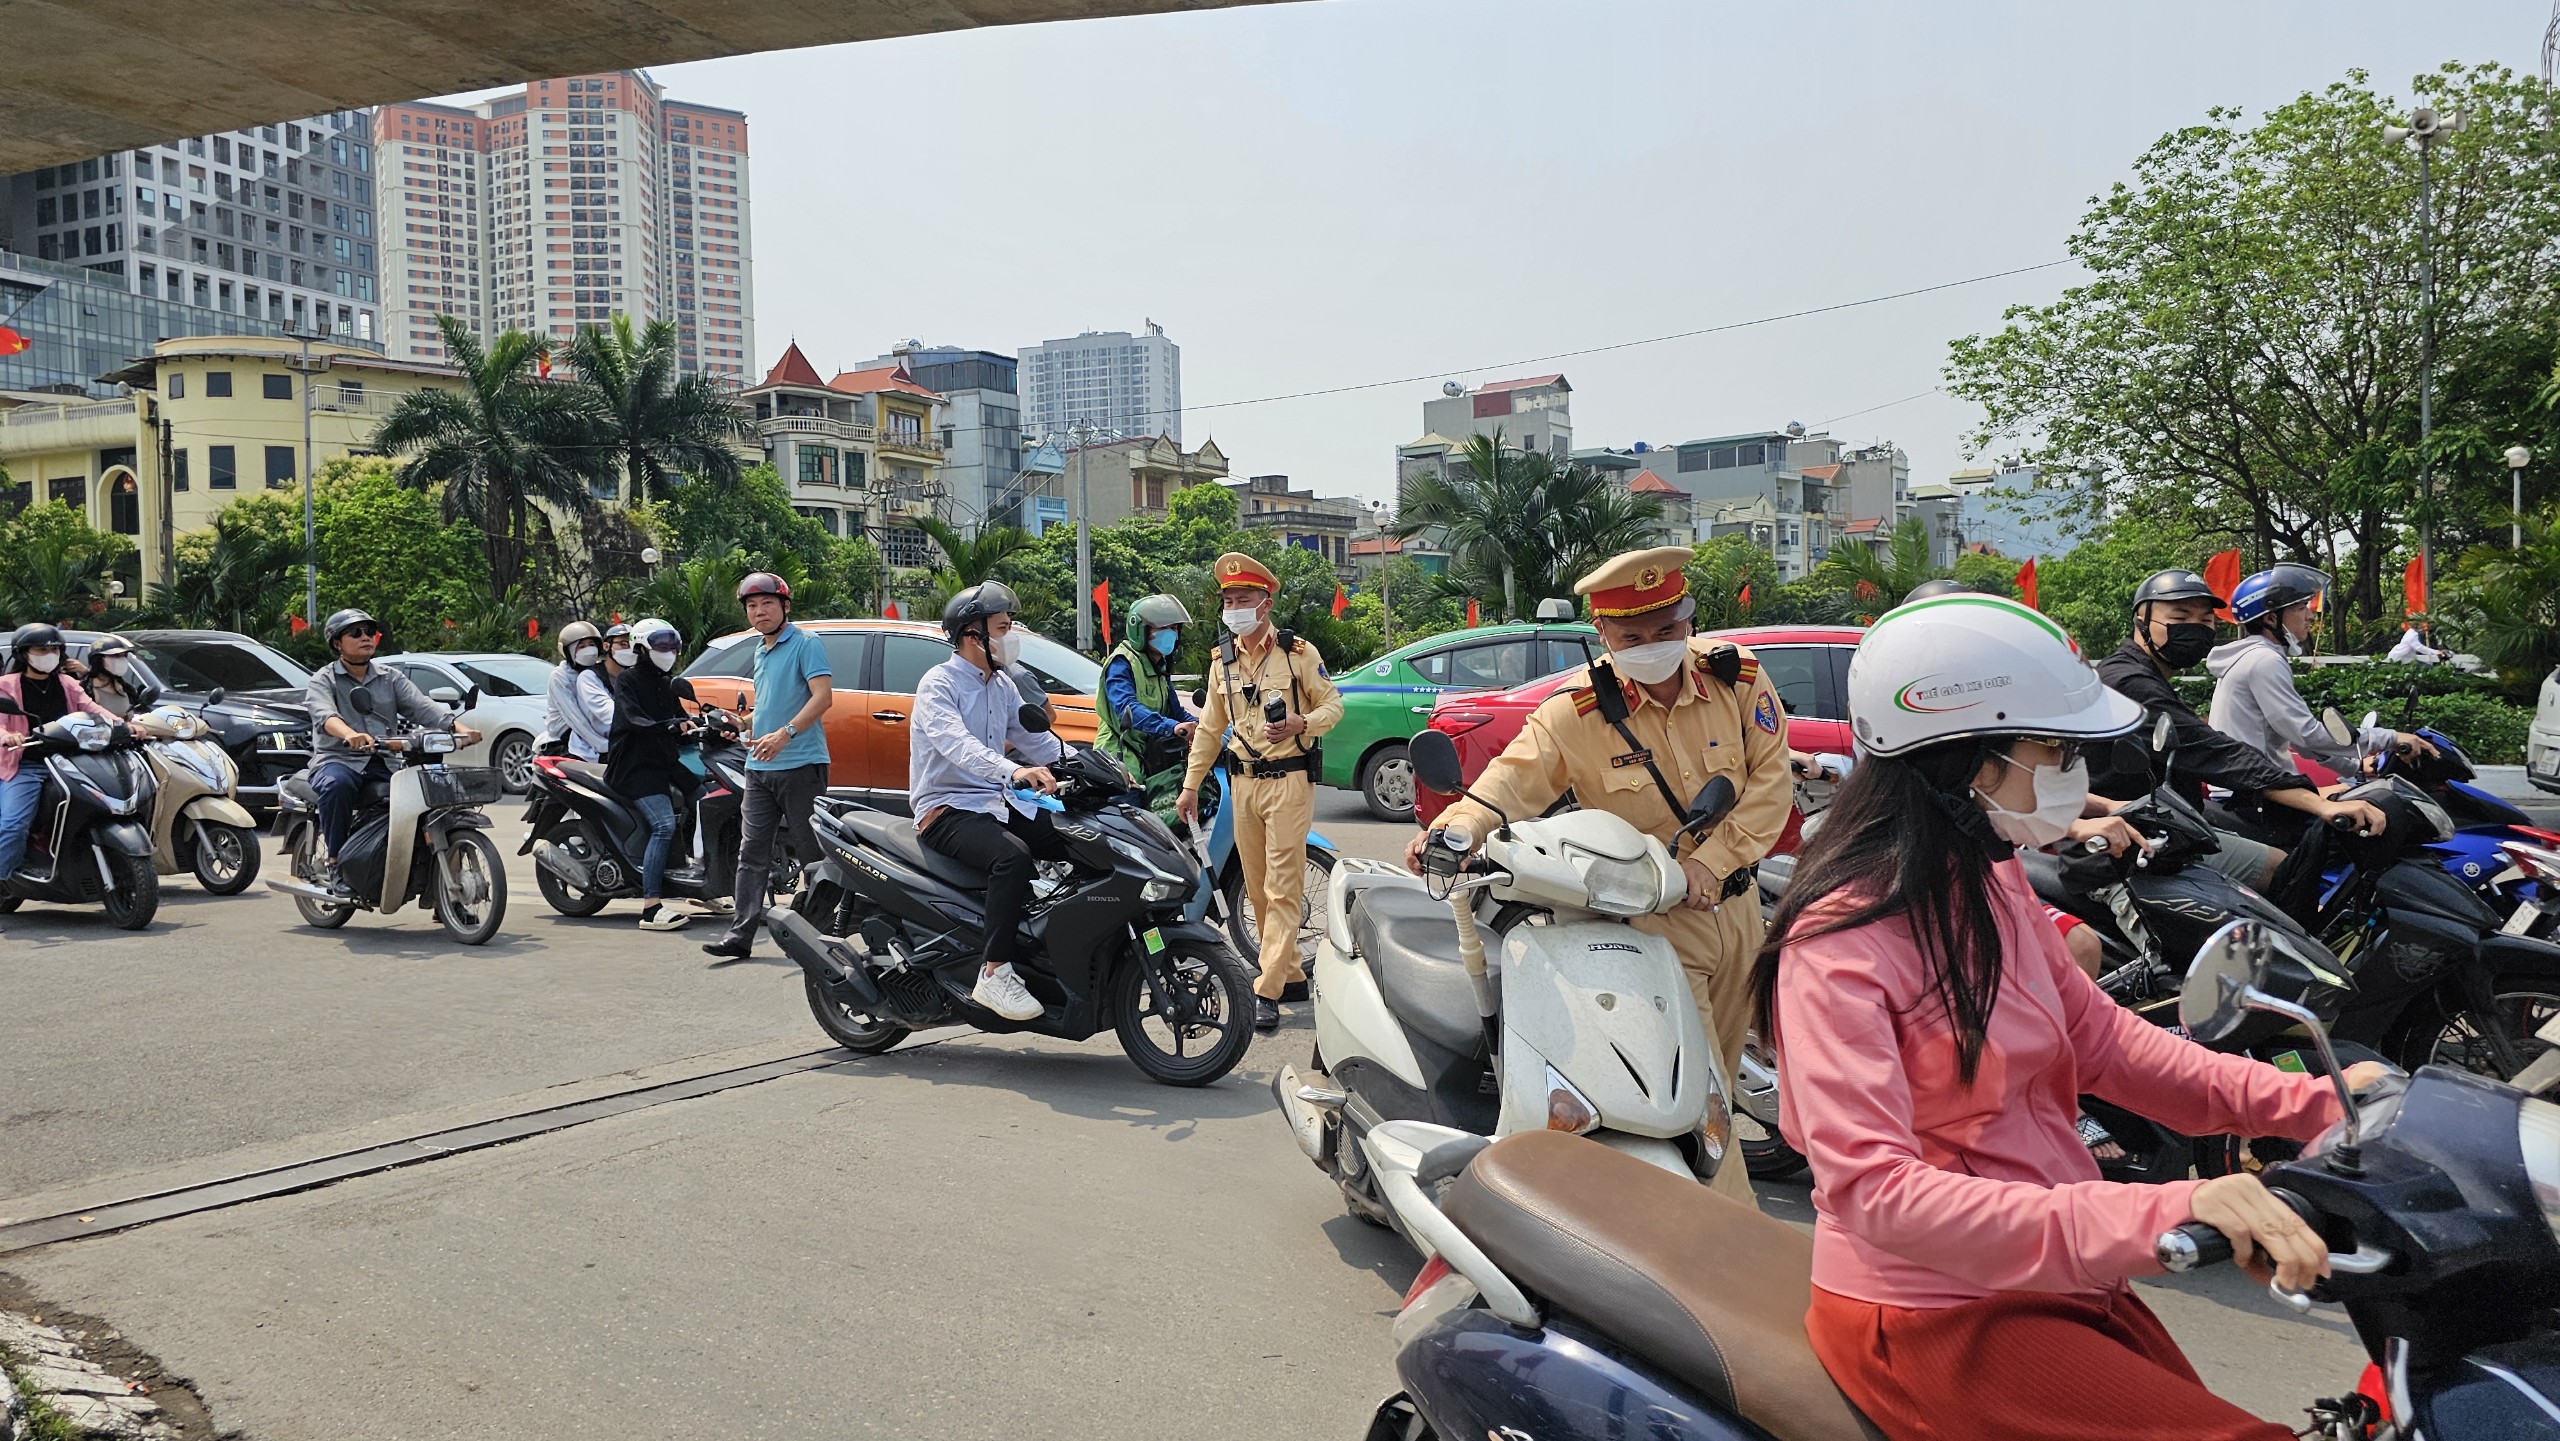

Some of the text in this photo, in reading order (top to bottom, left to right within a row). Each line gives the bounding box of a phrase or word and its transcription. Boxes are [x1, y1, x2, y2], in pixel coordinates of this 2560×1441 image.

[1967, 681, 1982, 692] XE
[1151, 793, 1177, 809] Grab
[1588, 943, 1642, 954] HONDA
